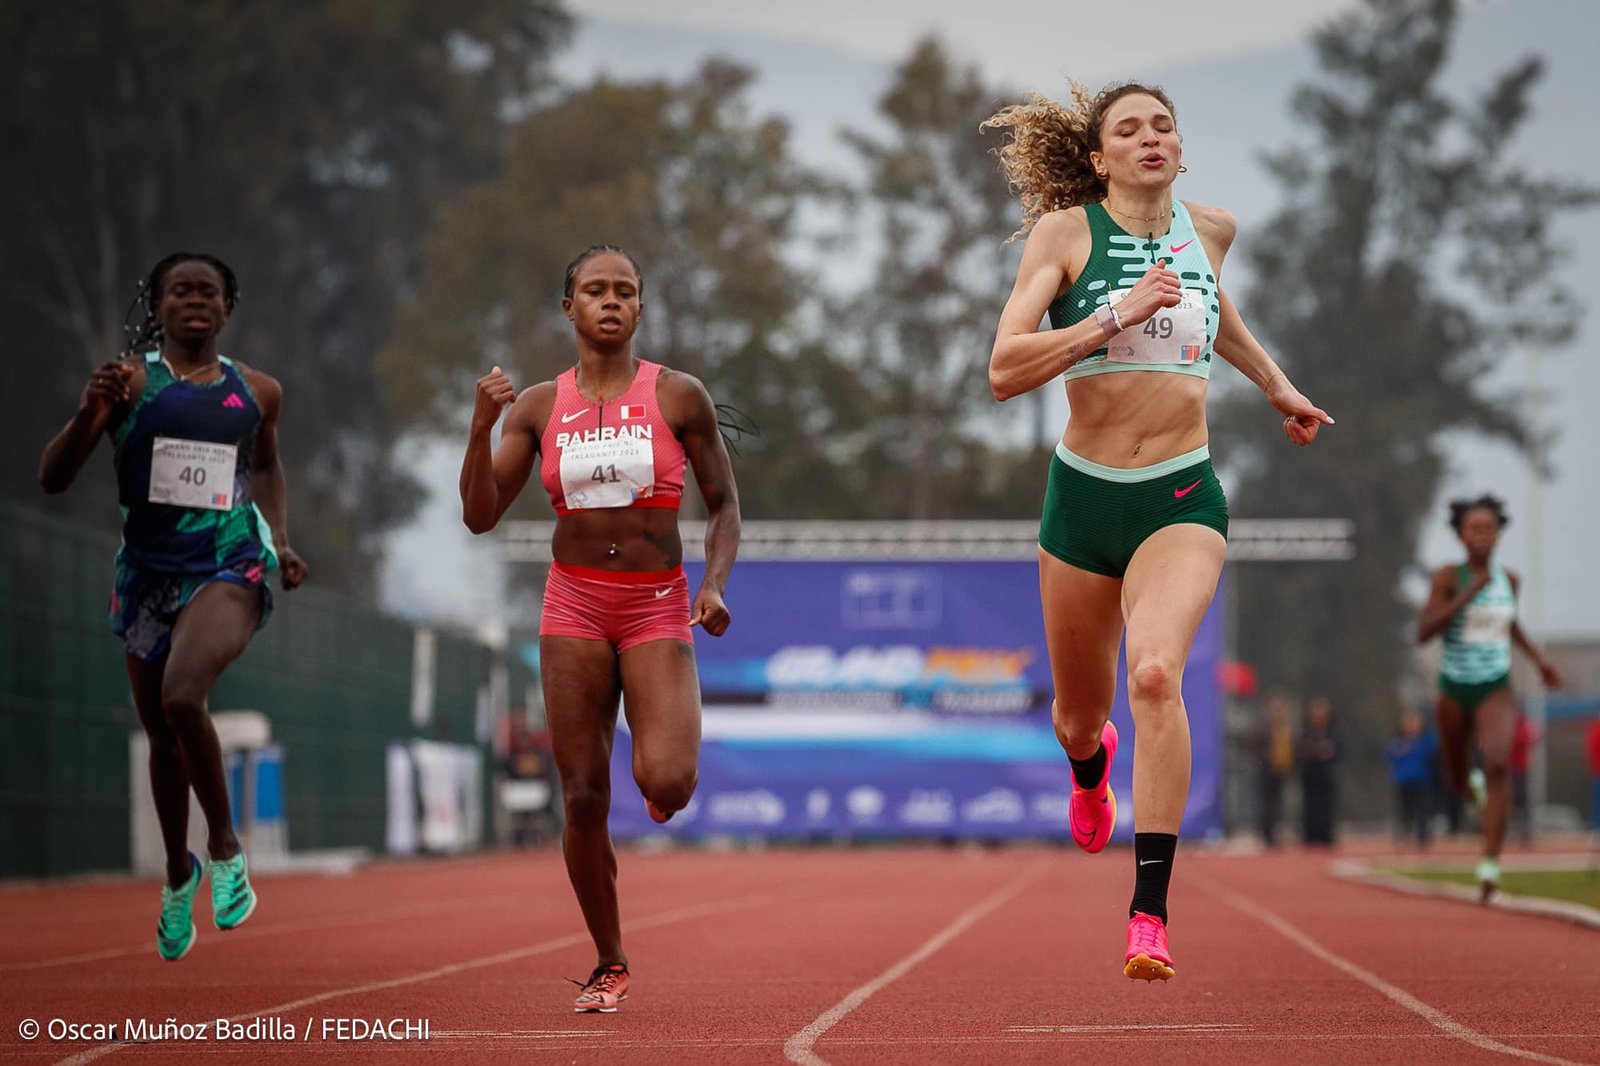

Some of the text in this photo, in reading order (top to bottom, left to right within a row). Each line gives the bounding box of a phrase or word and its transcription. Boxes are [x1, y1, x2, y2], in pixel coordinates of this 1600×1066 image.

[1143, 317, 1173, 339] 49
[556, 424, 653, 448] BAHRAIN
[179, 466, 206, 486] 40
[591, 464, 621, 483] 41
